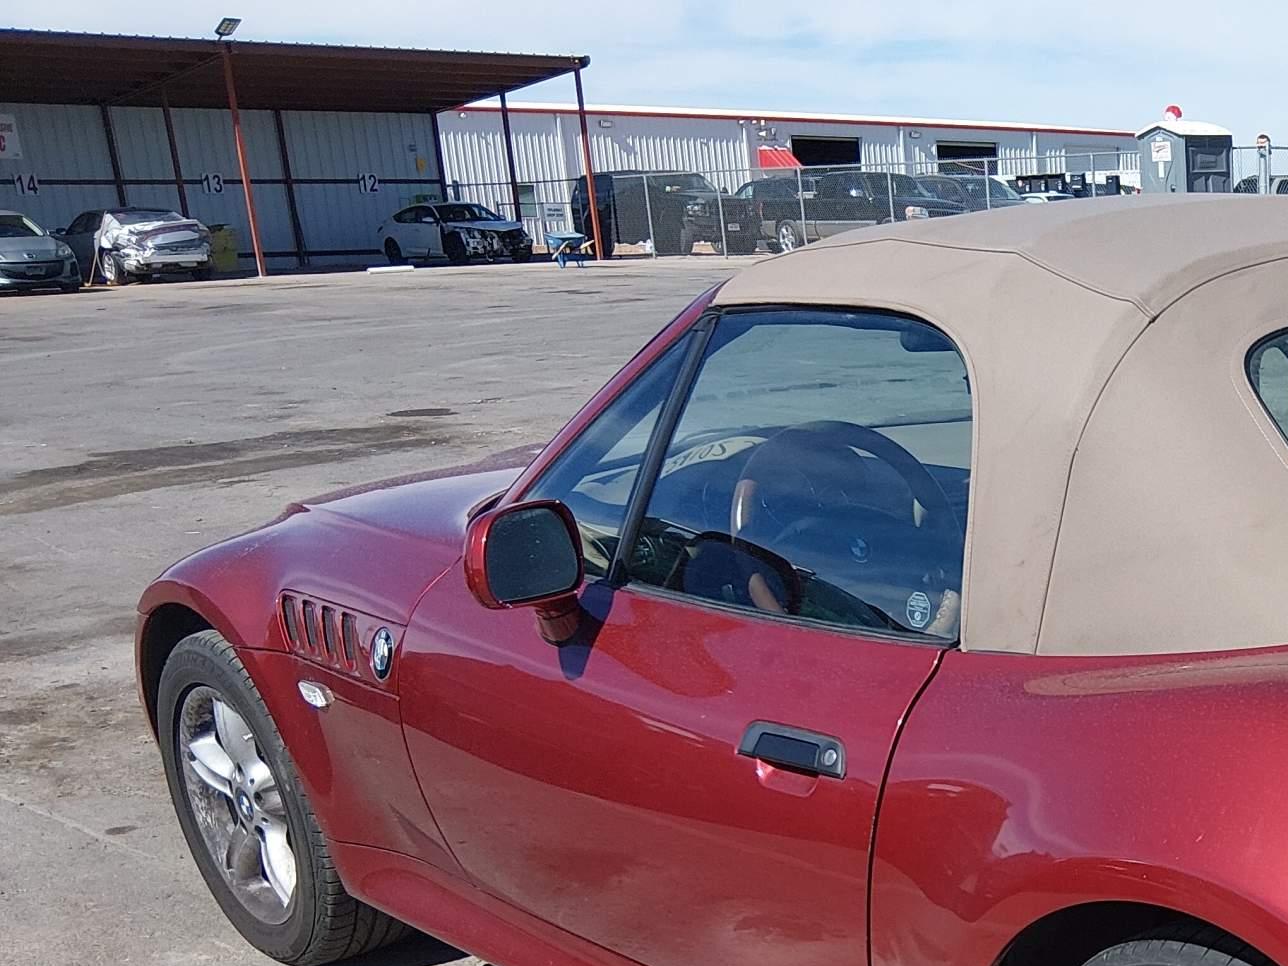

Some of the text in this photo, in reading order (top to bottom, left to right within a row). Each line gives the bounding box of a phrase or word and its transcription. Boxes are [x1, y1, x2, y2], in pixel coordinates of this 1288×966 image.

[16, 174, 38, 195] 14
[203, 174, 223, 193] 13
[361, 174, 379, 193] 12
